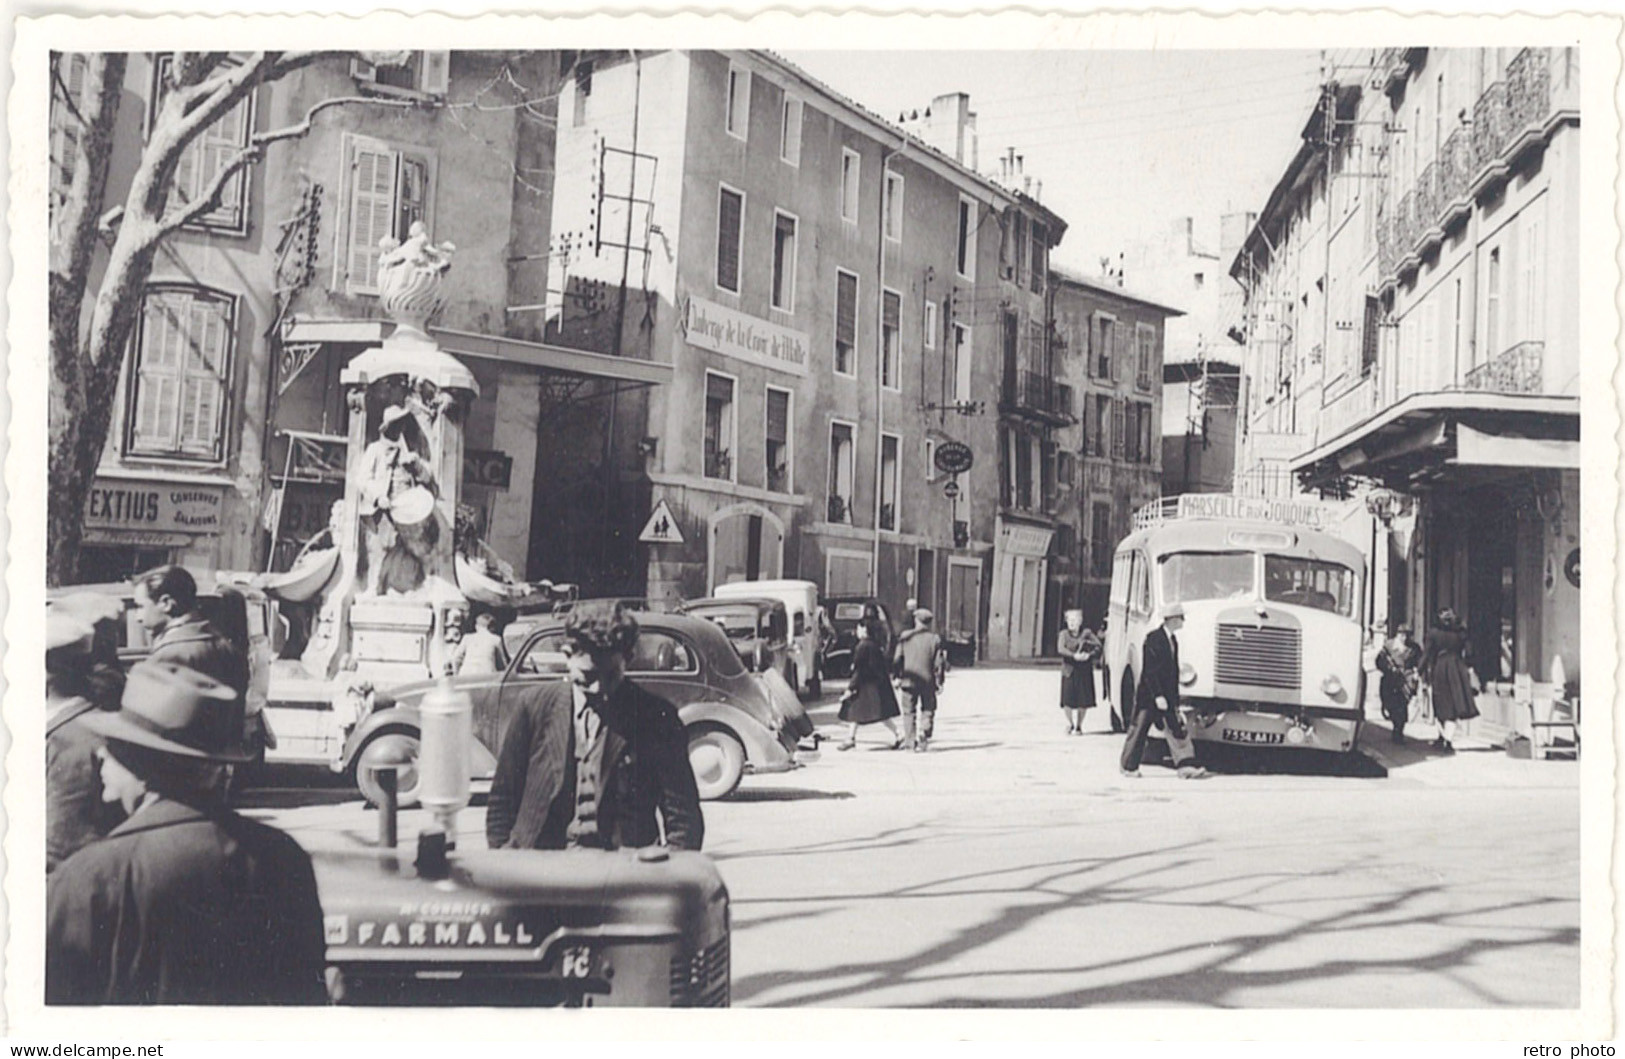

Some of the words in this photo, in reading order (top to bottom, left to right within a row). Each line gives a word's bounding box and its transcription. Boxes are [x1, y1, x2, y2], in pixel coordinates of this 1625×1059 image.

[726, 318, 736, 343] de
[1181, 496, 1244, 519] MARSEILLE
[1265, 502, 1321, 527] JOUQUES
[358, 921, 533, 945] FARMALL
